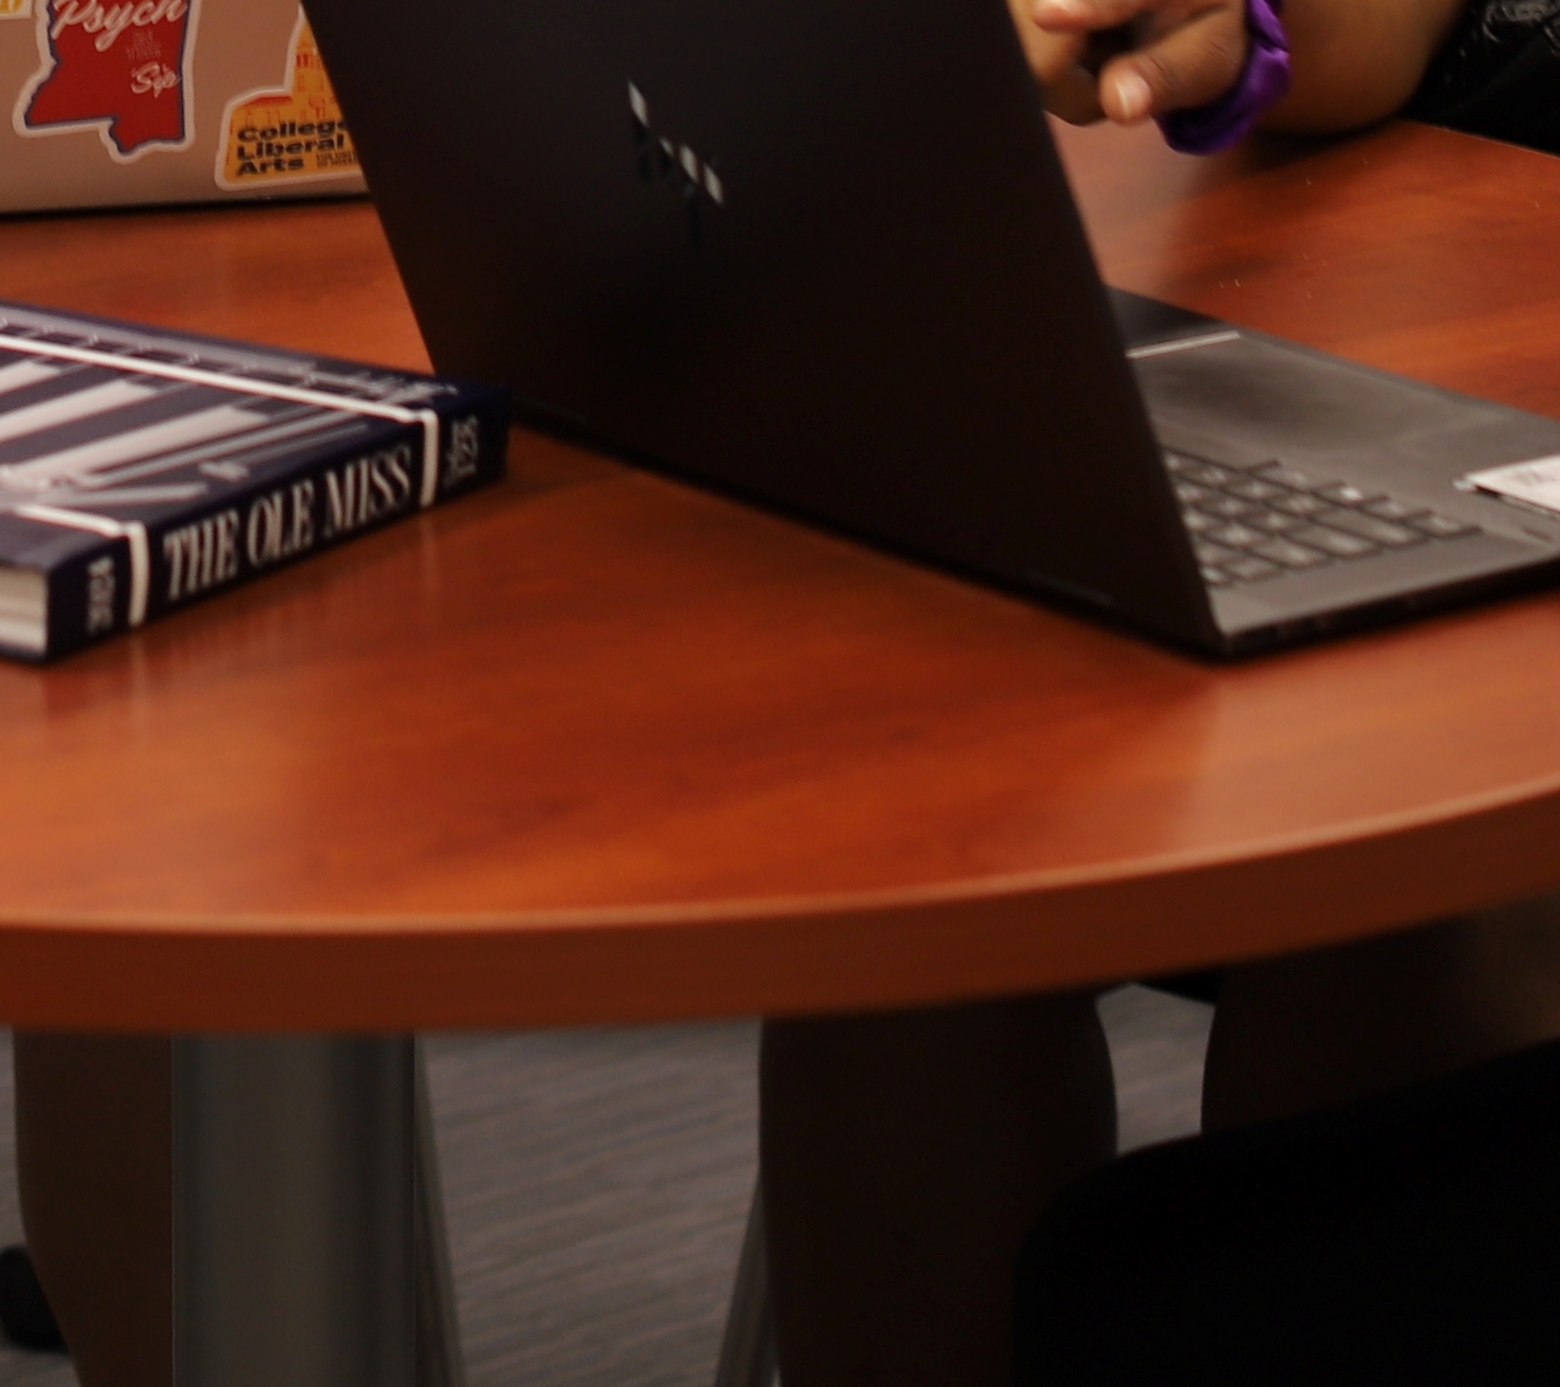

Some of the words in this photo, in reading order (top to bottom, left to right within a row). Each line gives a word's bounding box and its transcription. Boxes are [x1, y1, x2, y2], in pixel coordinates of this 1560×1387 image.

[236, 133, 346, 163] Liberal
[236, 156, 306, 178] Arts
[162, 506, 242, 604] THE
[245, 477, 316, 570] OLE
[320, 442, 413, 543] MISS
